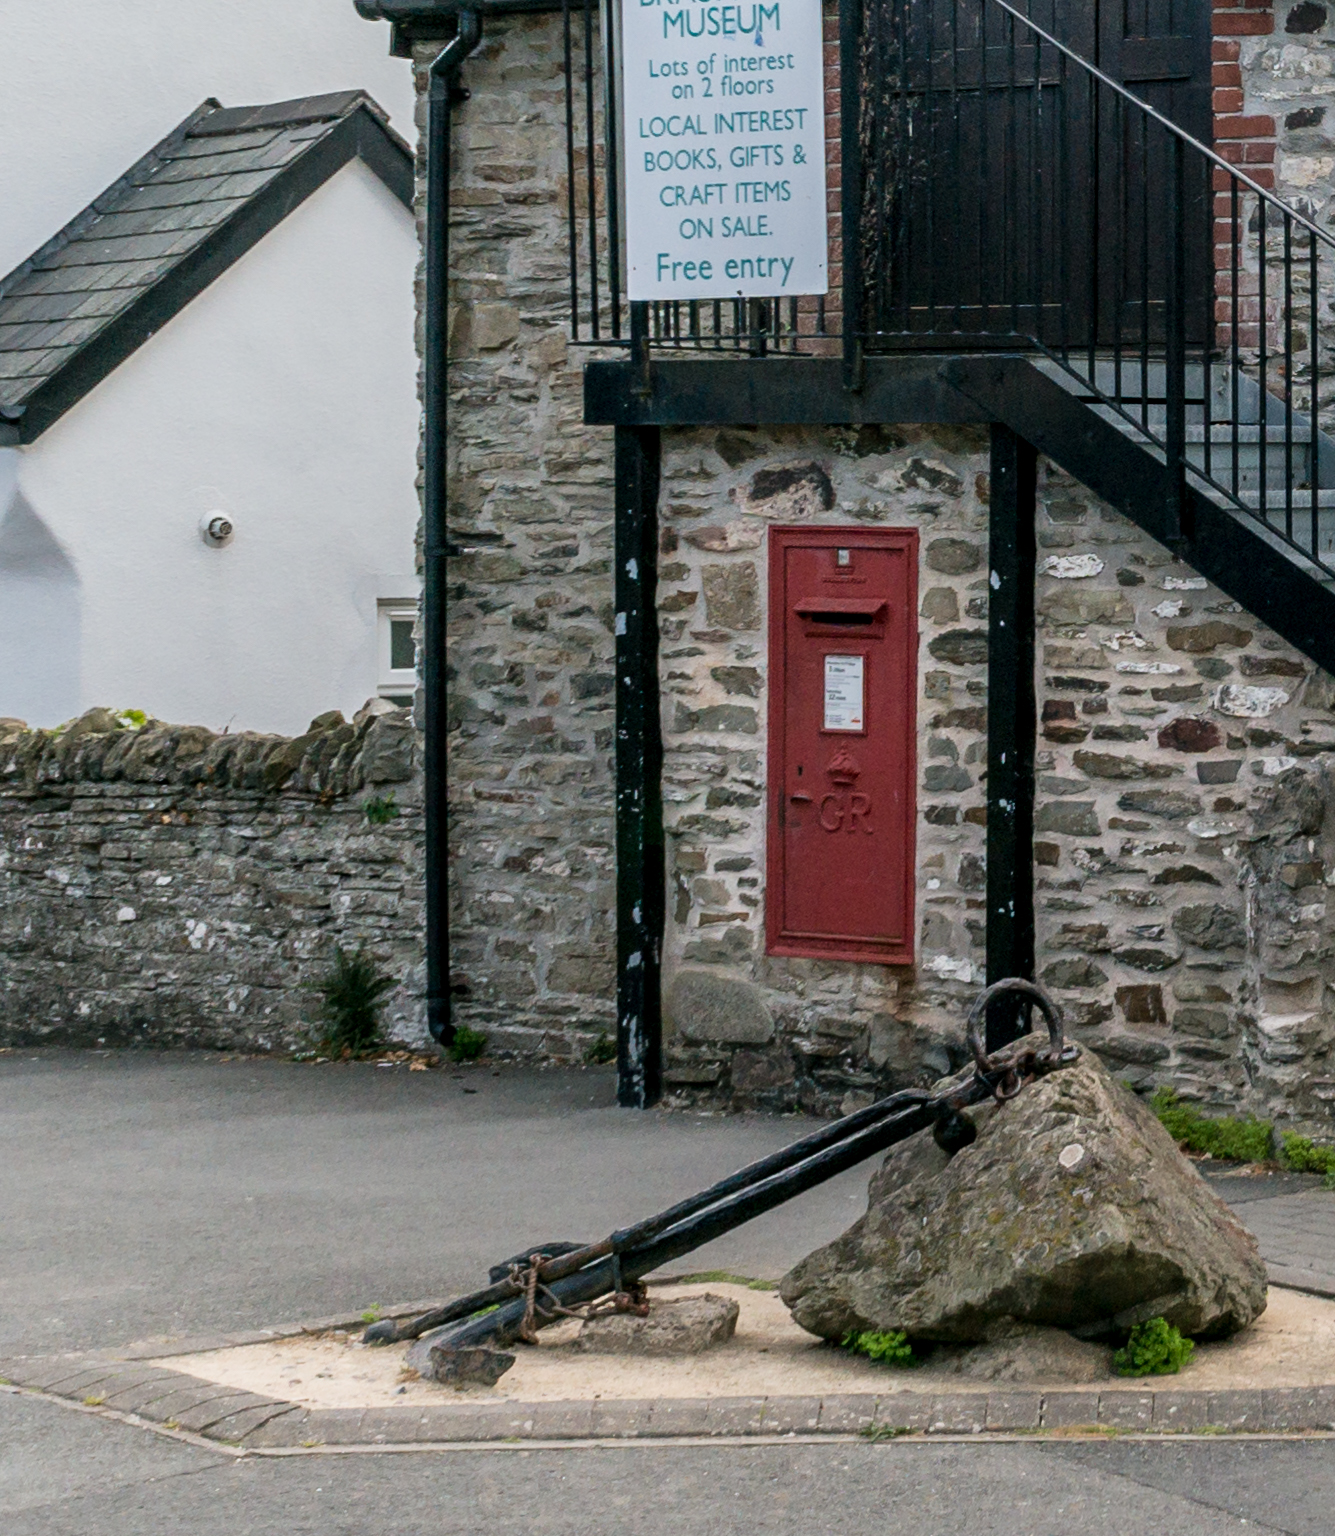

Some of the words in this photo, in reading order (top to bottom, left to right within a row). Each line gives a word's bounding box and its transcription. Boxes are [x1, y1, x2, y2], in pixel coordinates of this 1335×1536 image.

[663, 2, 780, 39] MUSEUM
[649, 59, 688, 78] Lots
[697, 55, 716, 74] of
[724, 53, 795, 73] interest
[671, 82, 695, 99] on
[702, 79, 713, 98] 2
[721, 76, 774, 96] floors
[639, 115, 707, 138] LOCAL
[715, 108, 809, 135] INTEREST
[644, 148, 723, 172] BOOKS,
[730, 145, 784, 168] GIFTS
[793, 144, 808, 165] &
[659, 183, 728, 207] CRAFT
[735, 180, 792, 203] ITEMS
[679, 218, 714, 240] ON
[721, 215, 774, 237] SALE.
[657, 252, 713, 281] Free
[724, 256, 795, 286] entry
[820, 791, 874, 835] GR
